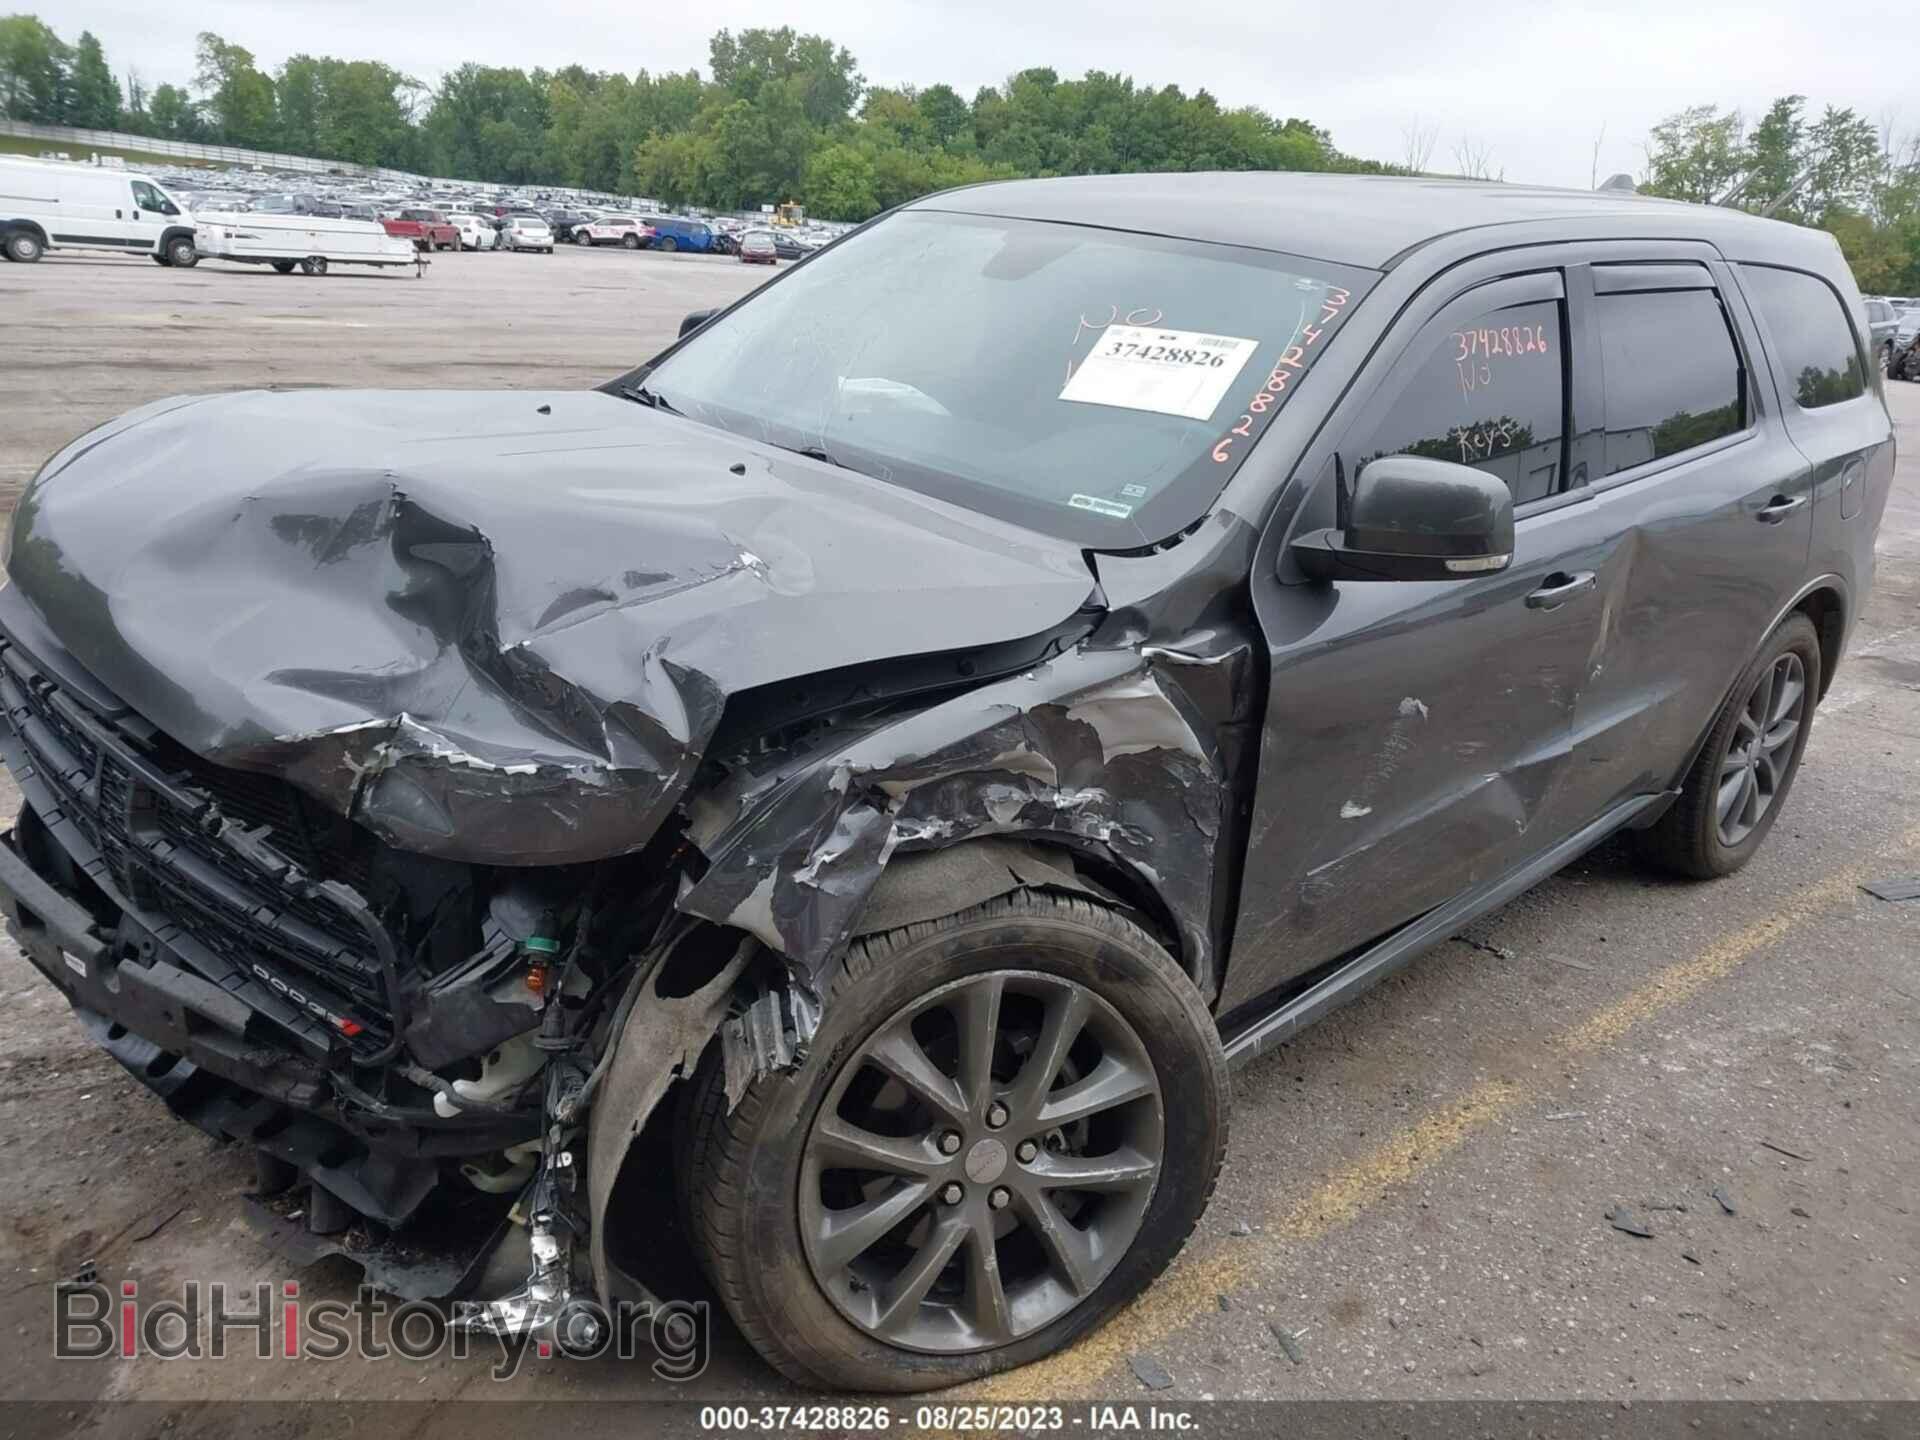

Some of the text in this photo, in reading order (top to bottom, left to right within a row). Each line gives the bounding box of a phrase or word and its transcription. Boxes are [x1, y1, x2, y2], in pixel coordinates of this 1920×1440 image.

[1105, 341, 1225, 369] 37428826
[1451, 325, 1547, 361] 37428826
[1211, 285, 1351, 463] 37428826
